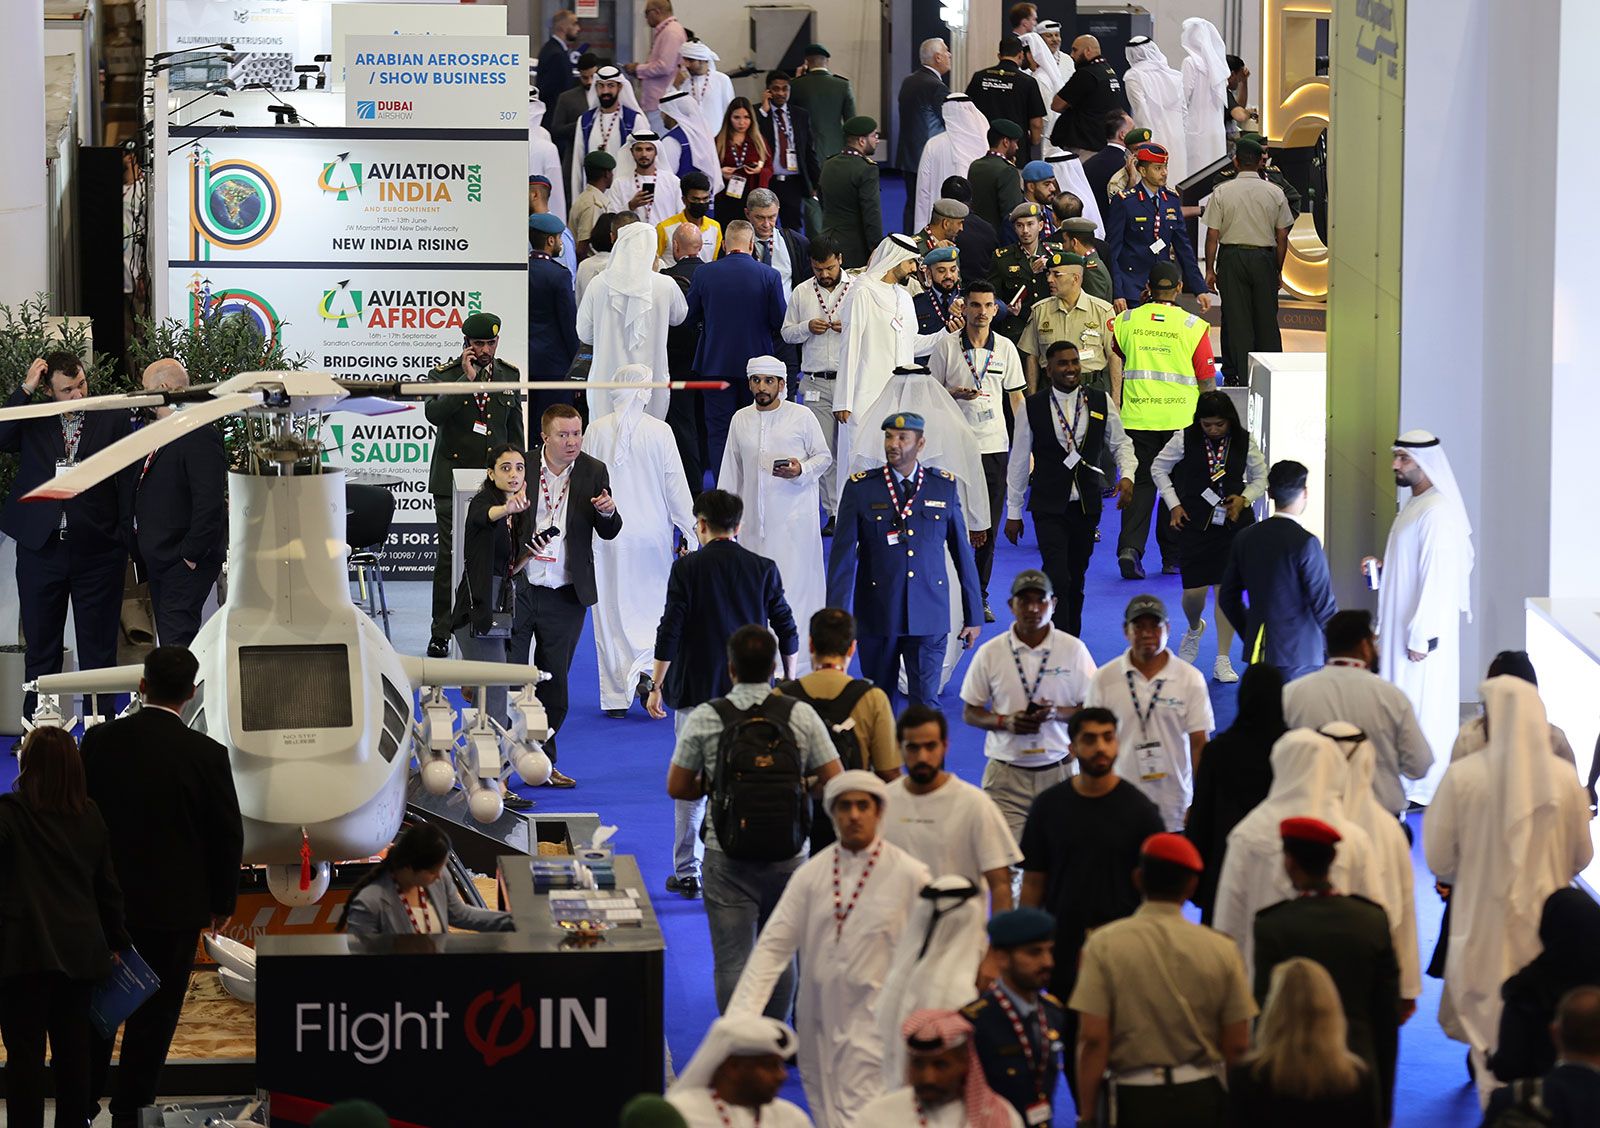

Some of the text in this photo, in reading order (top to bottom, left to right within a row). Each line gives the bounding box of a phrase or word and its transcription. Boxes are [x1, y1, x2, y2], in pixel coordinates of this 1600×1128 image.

[176, 36, 283, 45] ALUMINIUM EXTRUSIONS
[355, 53, 519, 66] ARABIAN AEROSPACE
[369, 72, 507, 85] / SHOW BUSINESS
[378, 101, 413, 111] DUBAI
[378, 112, 413, 120] AIRSHOW
[500, 112, 517, 120] 307
[367, 163, 465, 180] AVIATION
[467, 164, 482, 203] 2024
[379, 182, 452, 202] INDIA
[433, 225, 459, 233] Aerocity
[332, 238, 469, 251] NEW INDIA RISING
[367, 290, 465, 307] AVIATION
[467, 291, 482, 317] 024
[367, 308, 463, 329] AFRICA
[402, 333, 438, 341] September
[1145, 330, 1180, 339] OPERATIONS
[323, 356, 398, 368] BRIDGING
[402, 356, 441, 368] SKIES
[351, 425, 438, 440] AVIATION
[351, 442, 429, 463] SAUDI
[402, 533, 430, 545] FOR
[389, 552, 416, 560] 100987
[296, 1001, 450, 1065] Flight
